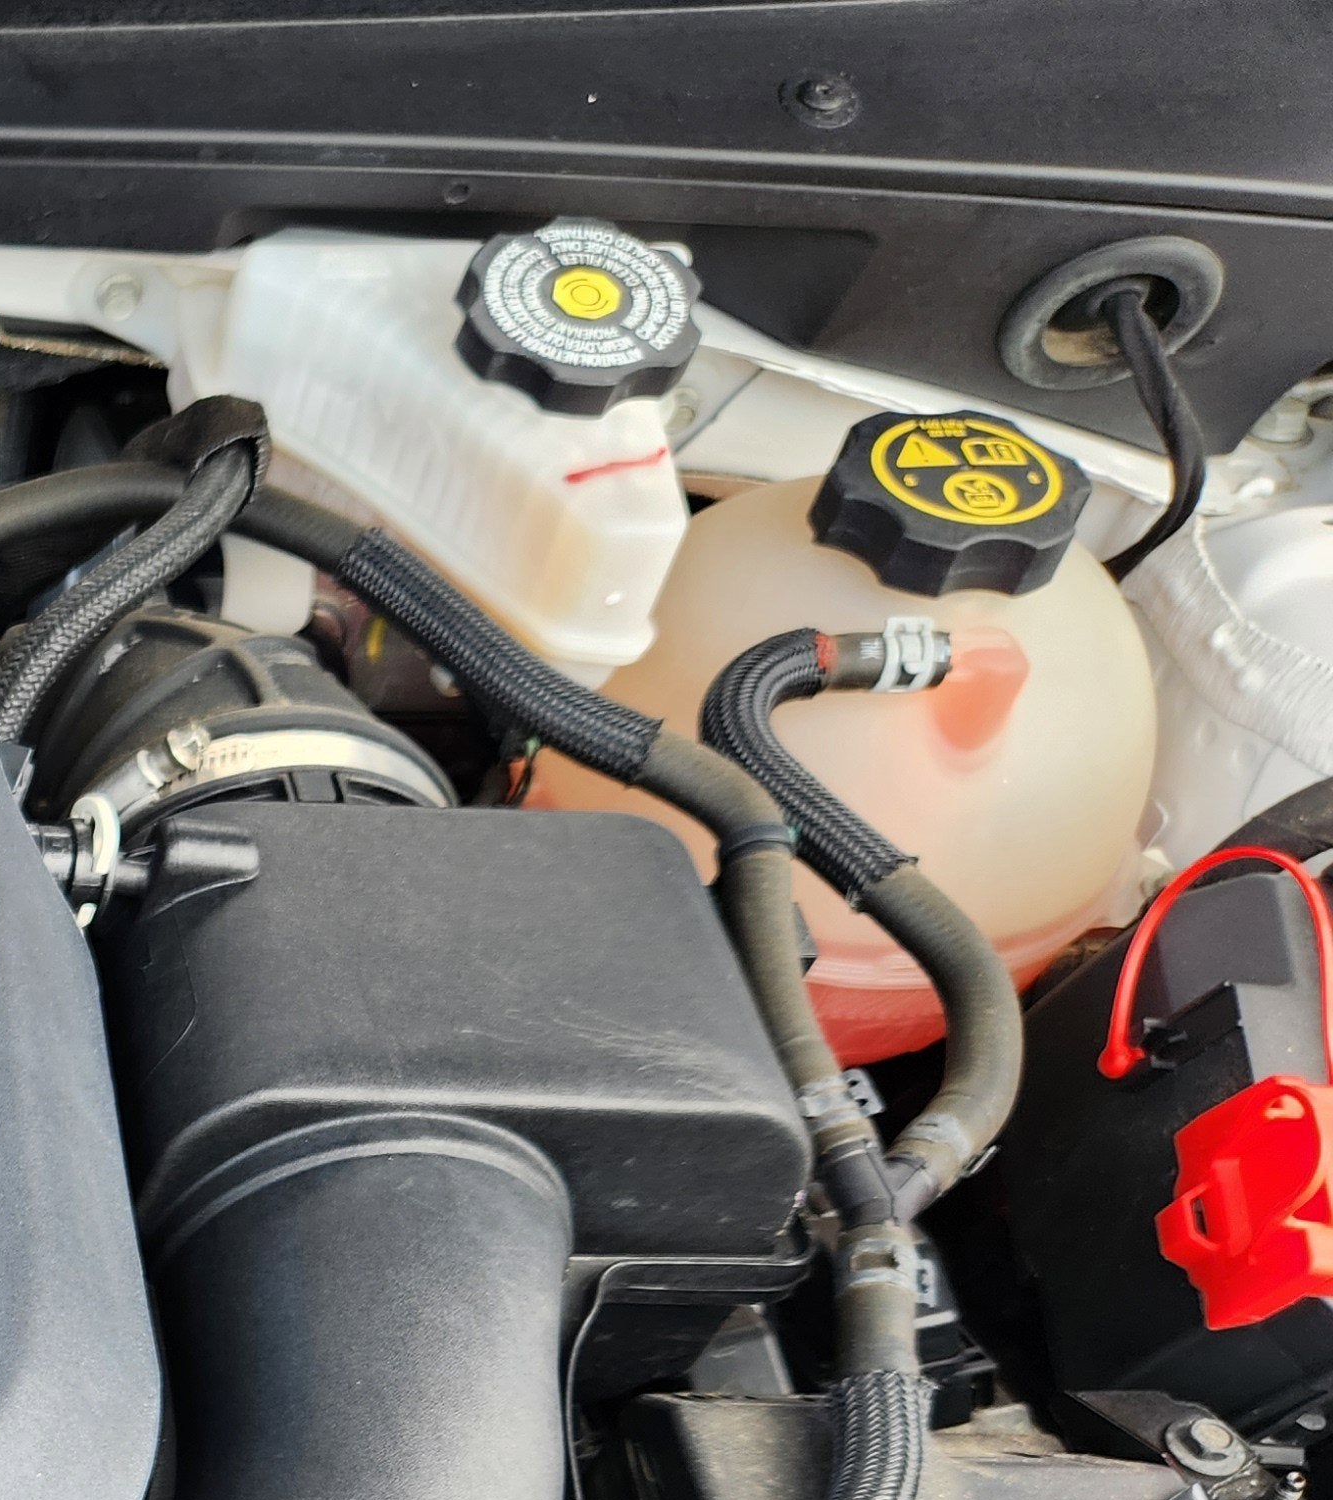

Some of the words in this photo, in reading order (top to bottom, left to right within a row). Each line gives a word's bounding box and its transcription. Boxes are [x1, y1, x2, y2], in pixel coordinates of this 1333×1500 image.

[545, 241, 582, 255] ONLY
[555, 253, 605, 267] FILLER
[602, 260, 641, 287] CLEAN
